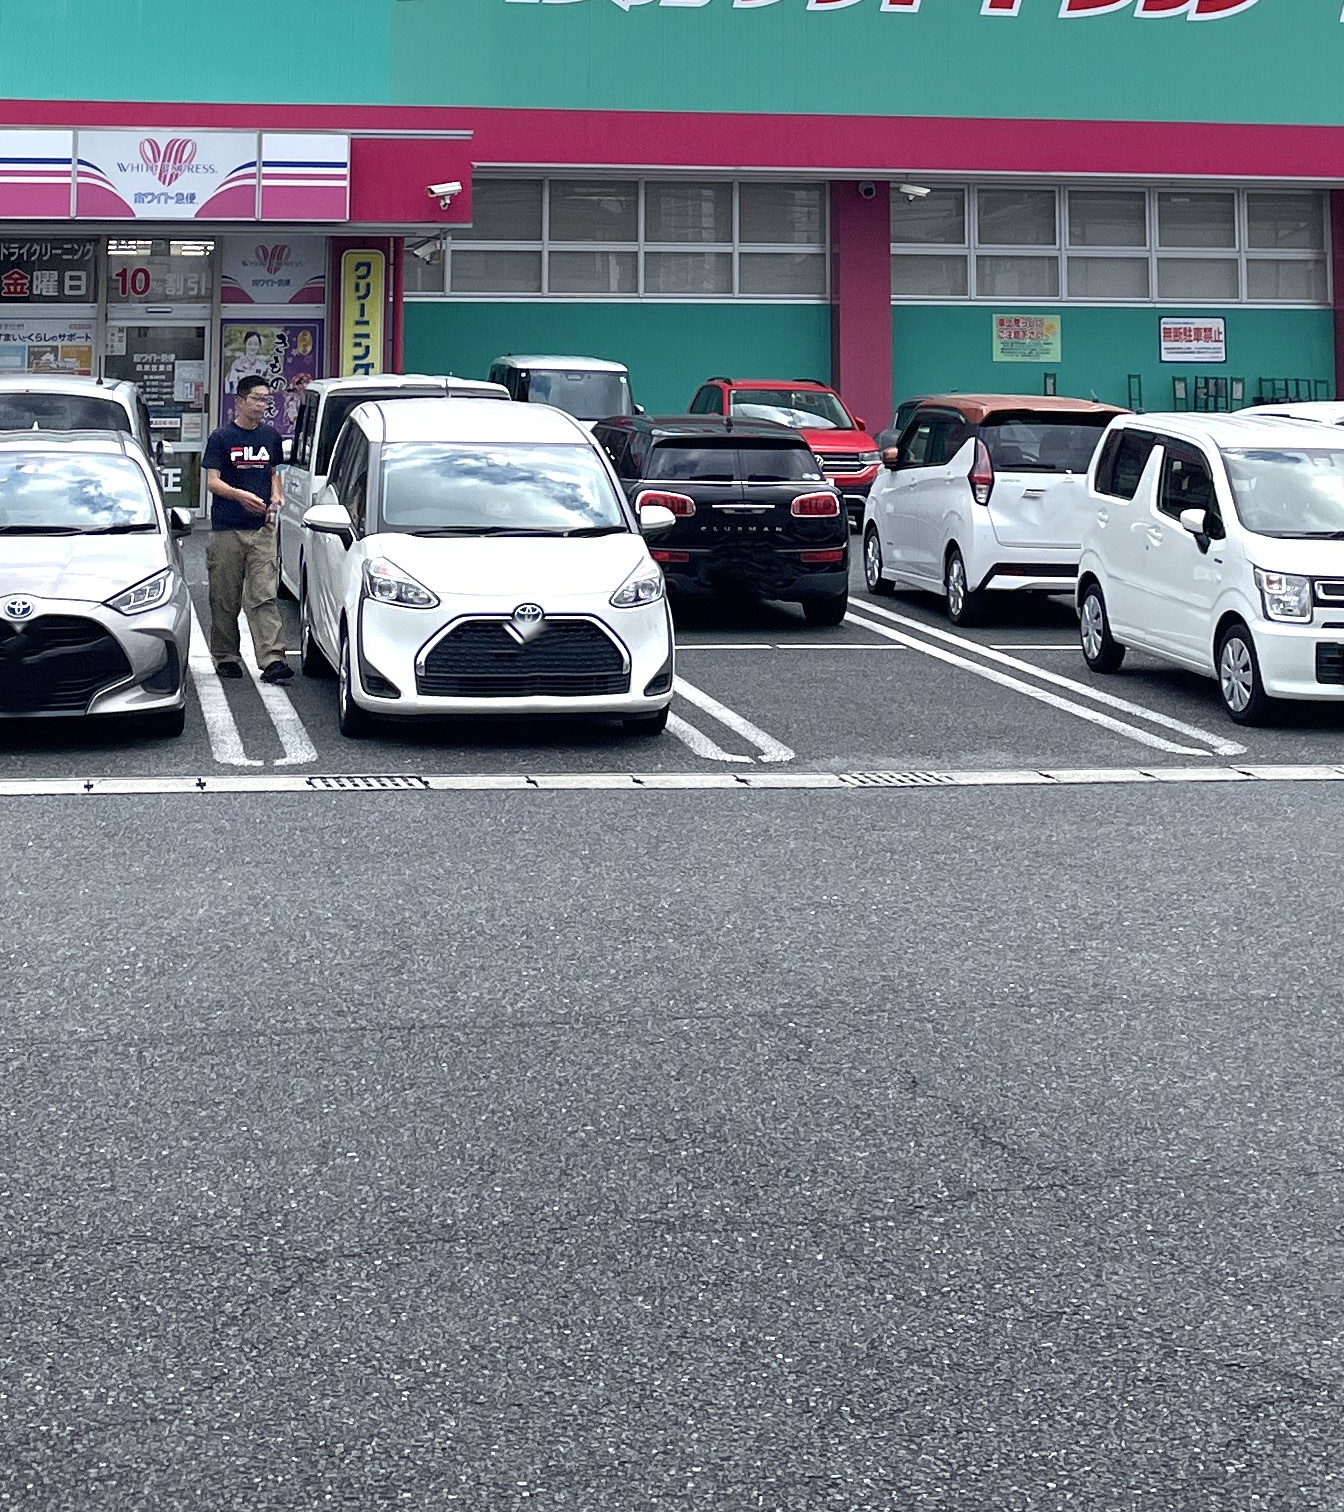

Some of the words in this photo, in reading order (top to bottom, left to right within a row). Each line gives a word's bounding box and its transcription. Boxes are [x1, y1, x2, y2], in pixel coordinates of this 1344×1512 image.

[133, 191, 197, 205] ホワイト急便
[0, 242, 95, 262] ドライクリーニング
[1, 268, 88, 298] 金曜日
[1163, 326, 1224, 344] 無断駐車禁止
[230, 446, 270, 462] FILA
